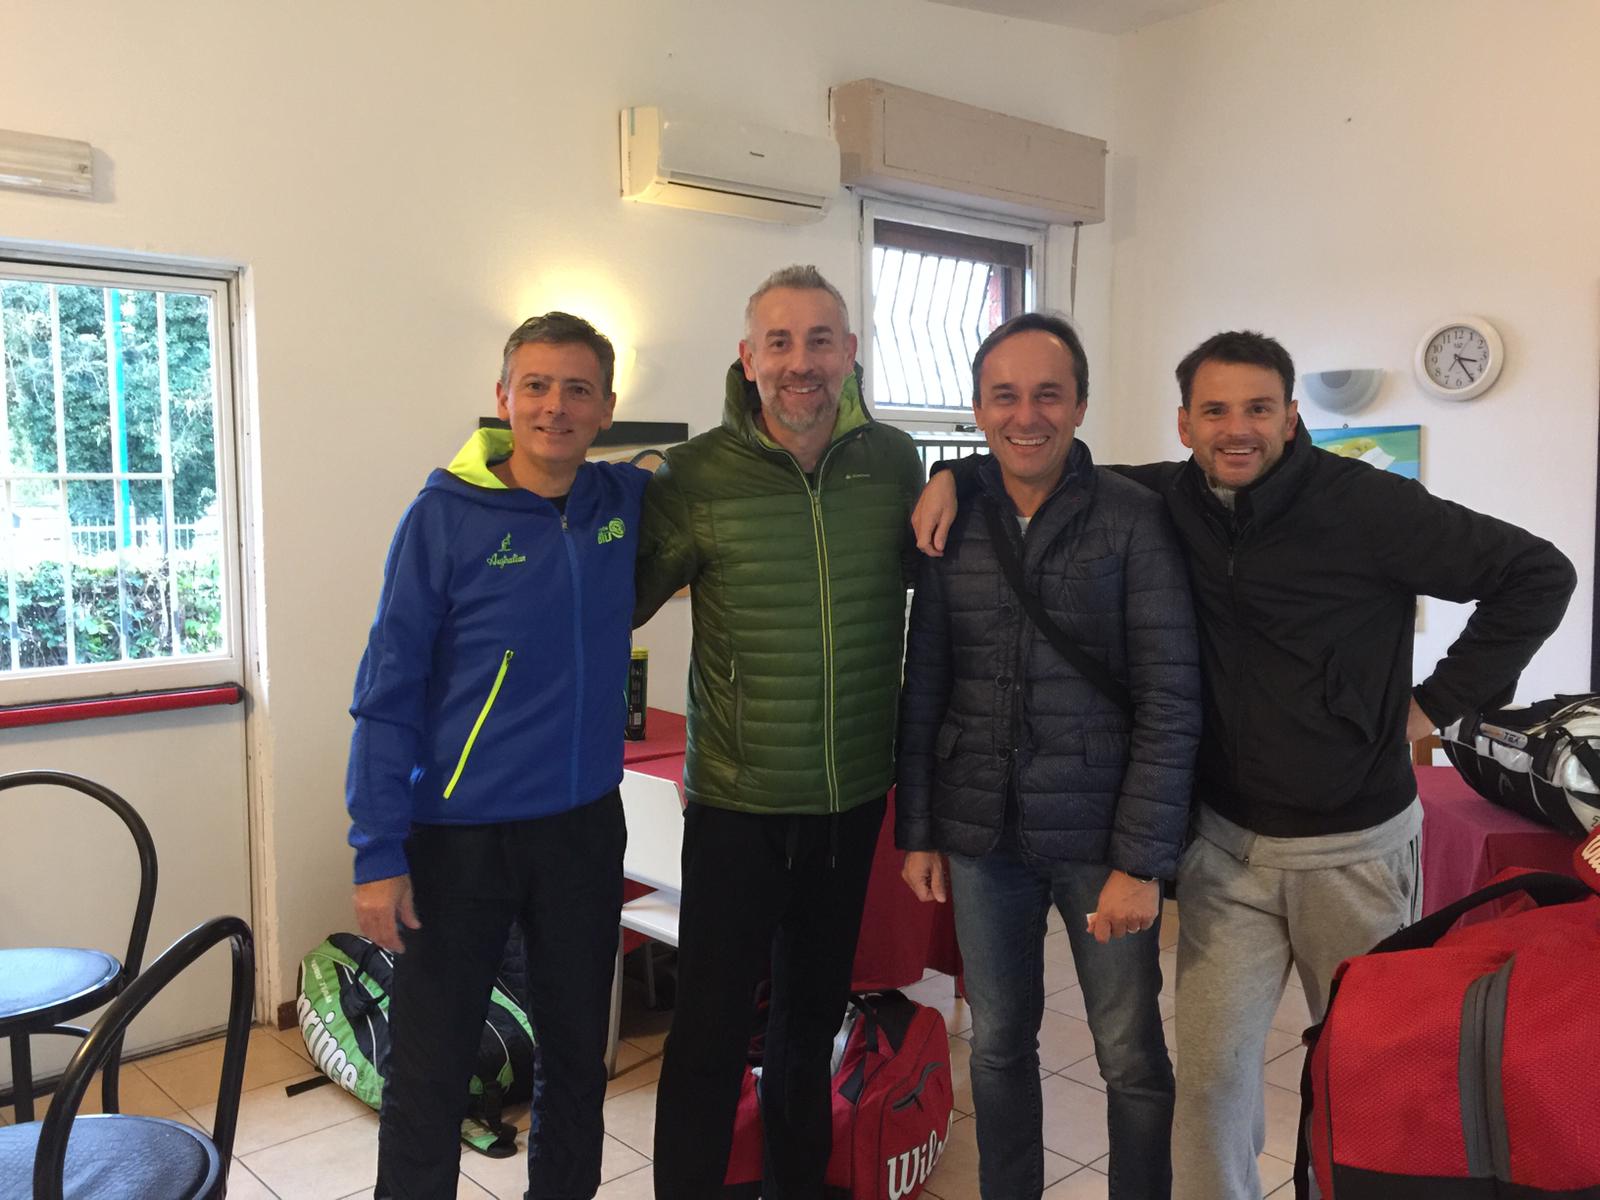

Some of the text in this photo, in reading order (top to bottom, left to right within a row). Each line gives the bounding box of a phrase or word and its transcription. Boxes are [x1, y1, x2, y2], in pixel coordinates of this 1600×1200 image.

[1454, 329, 1463, 339] 12
[1442, 334, 1451, 345] 11
[1477, 339, 1484, 349] 2
[1431, 344, 1443, 354] 10
[1431, 355, 1438, 364] 9
[1480, 351, 1487, 361] 3
[1435, 367, 1441, 377] 8
[1476, 363, 1483, 373] 4
[1444, 375, 1450, 385] 7
[1456, 378, 1463, 387] 6
